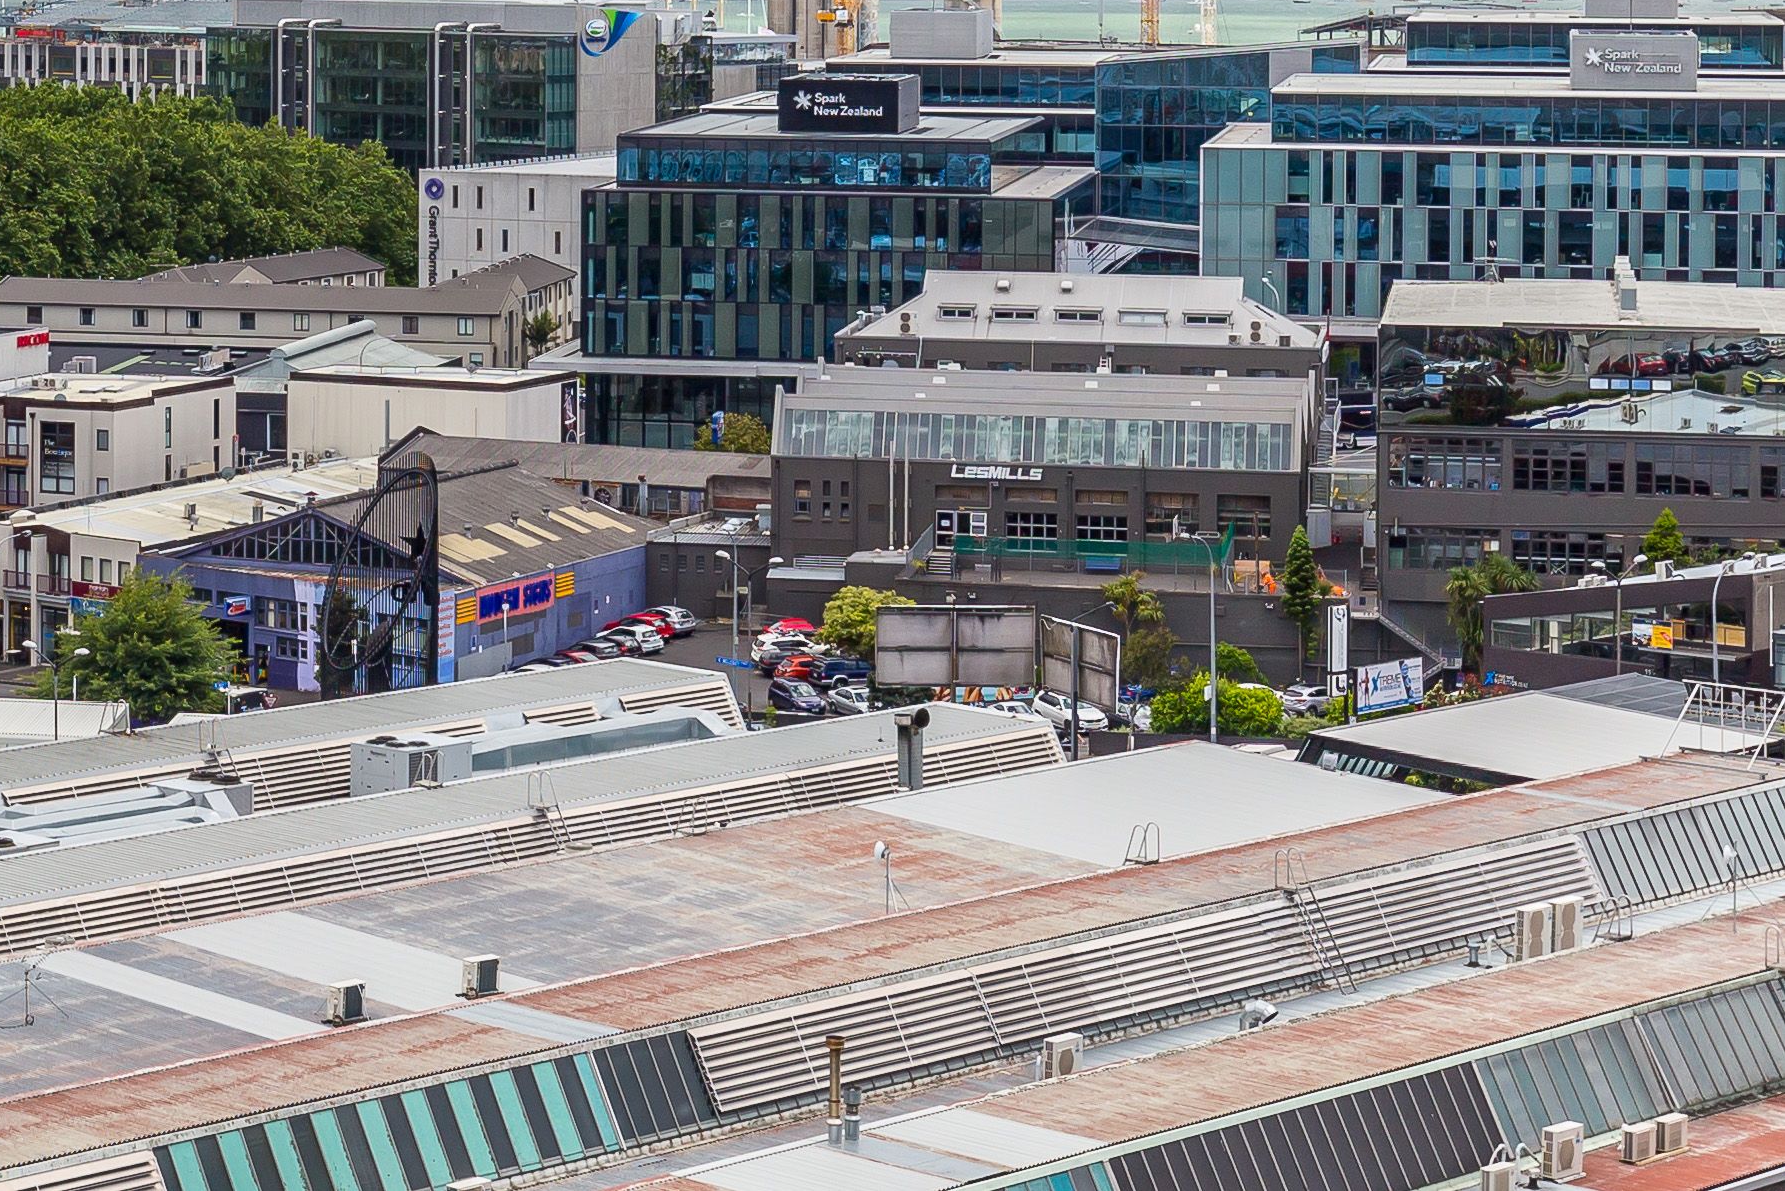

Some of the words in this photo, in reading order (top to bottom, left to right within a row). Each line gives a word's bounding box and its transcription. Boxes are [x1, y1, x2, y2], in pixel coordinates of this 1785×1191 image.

[1604, 48, 1639, 60] Spark
[1603, 62, 1631, 73] New
[1635, 62, 1682, 74] Zealand
[814, 92, 846, 105] Spark
[813, 105, 839, 116] New
[839, 105, 883, 116] Zealand
[428, 205, 440, 238] Grant
